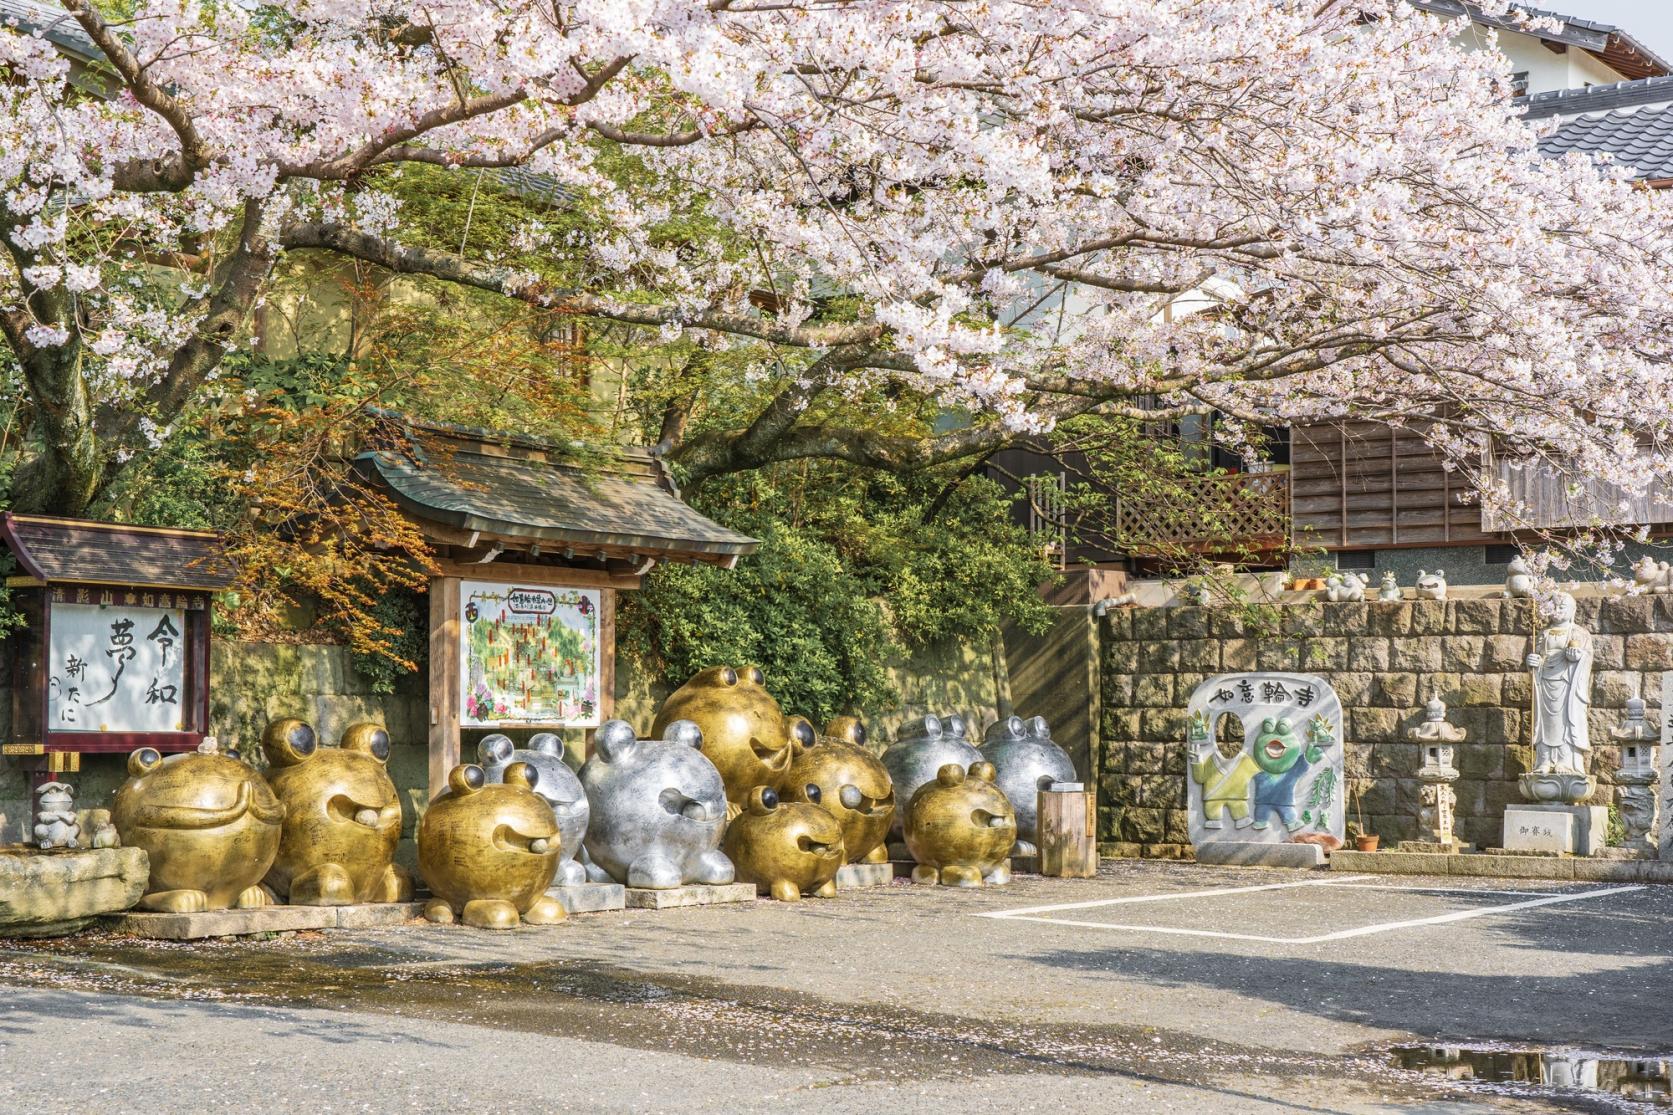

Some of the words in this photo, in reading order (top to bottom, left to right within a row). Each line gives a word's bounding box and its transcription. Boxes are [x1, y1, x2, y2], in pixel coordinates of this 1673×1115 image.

[62, 654, 88, 722] 新たに
[85, 618, 137, 706] 夢
[147, 614, 180, 704] 令和
[1209, 679, 1314, 706] 如意輪寺
